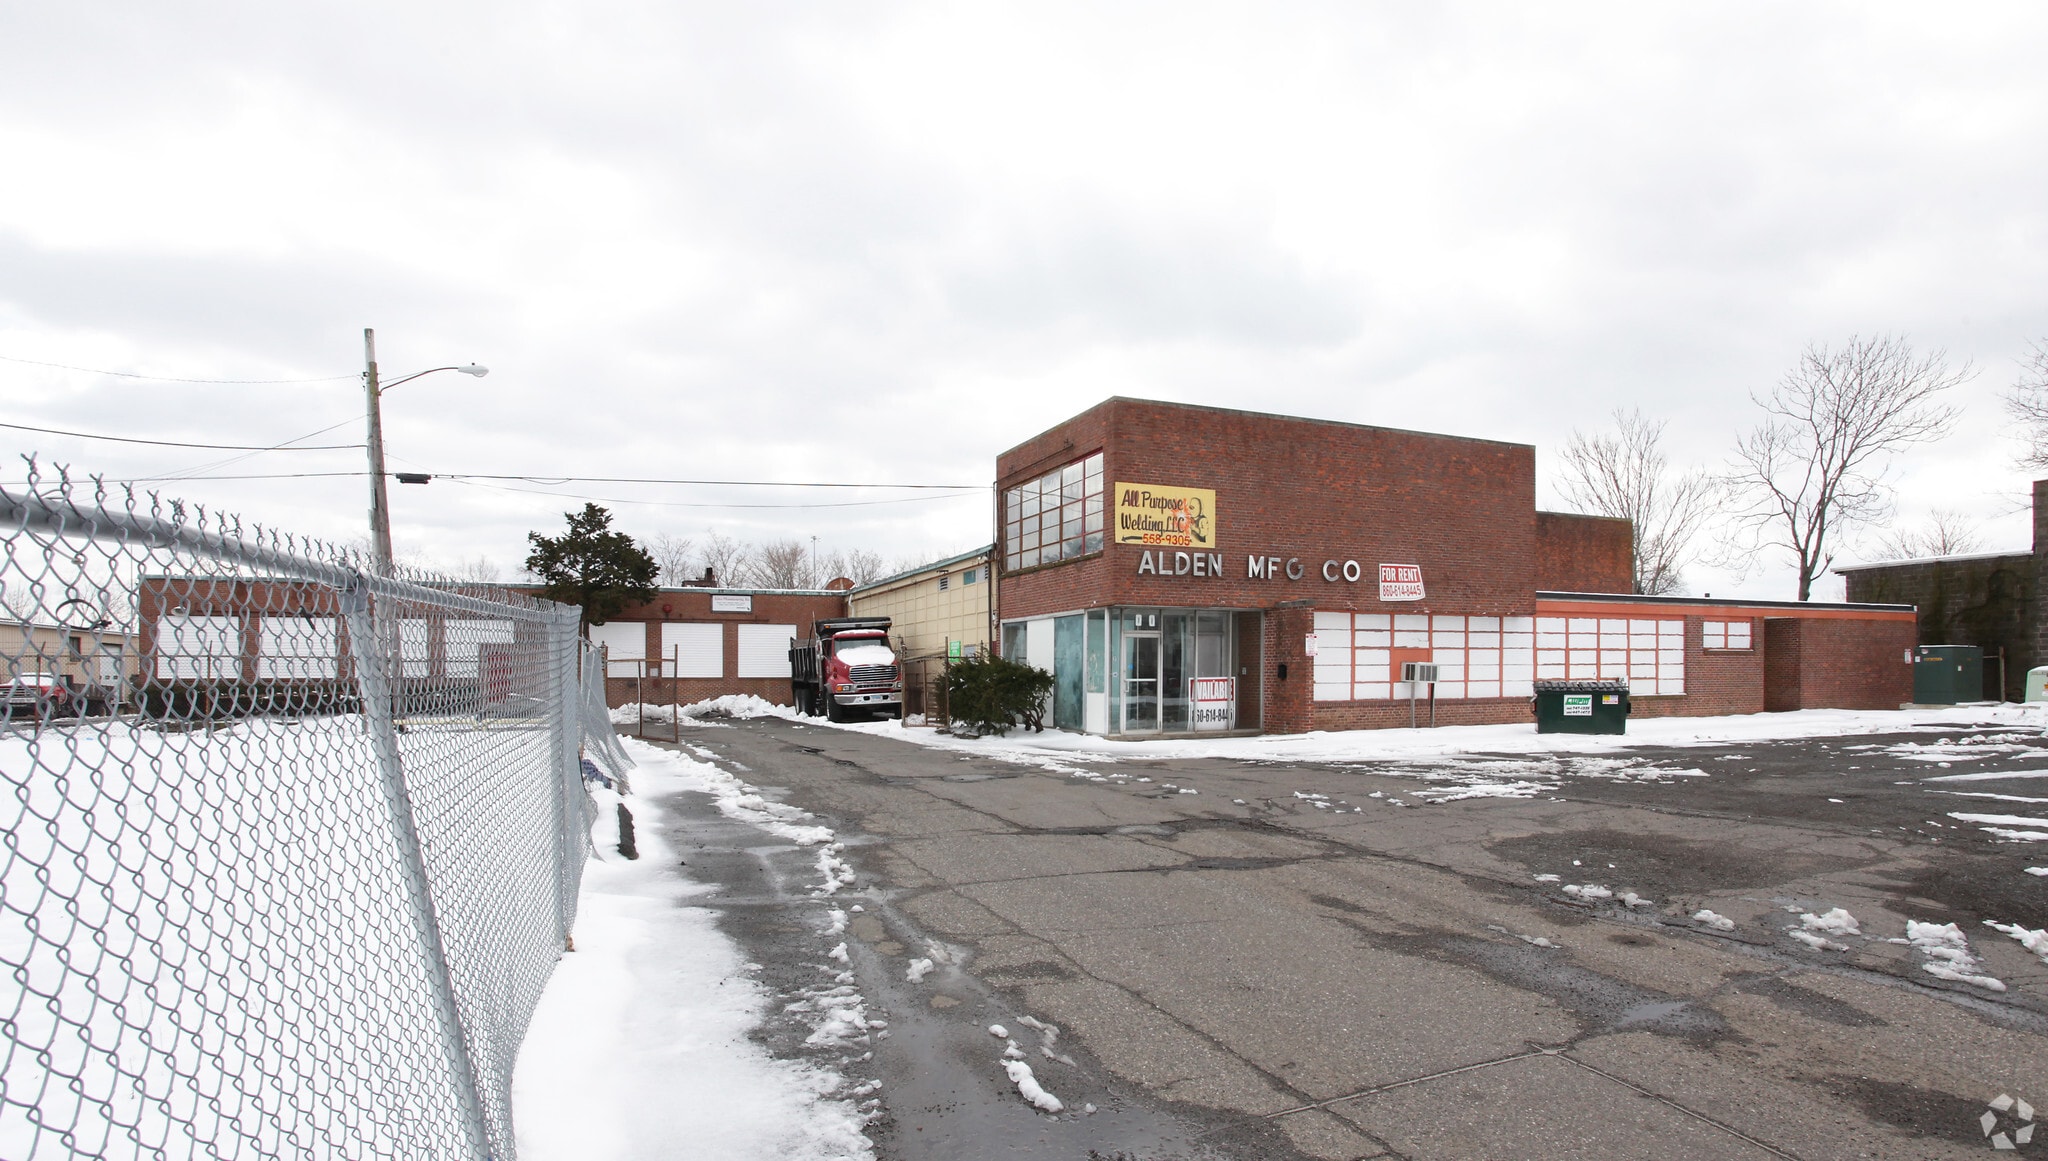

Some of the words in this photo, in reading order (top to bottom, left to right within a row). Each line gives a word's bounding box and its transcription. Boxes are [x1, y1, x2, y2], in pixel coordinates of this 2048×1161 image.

[1121, 490, 1139, 508] All
[1141, 491, 1184, 514] Purpose
[1165, 516, 1185, 533] LLC
[1142, 533, 1191, 546] 558-9305
[1138, 551, 1222, 577] ALDEN
[1248, 555, 1304, 580] MFG
[1322, 560, 1361, 582] CO
[1382, 568, 1396, 581] FOR
[1398, 568, 1418, 582] RENT
[1383, 584, 1421, 597] 860-614-8445
